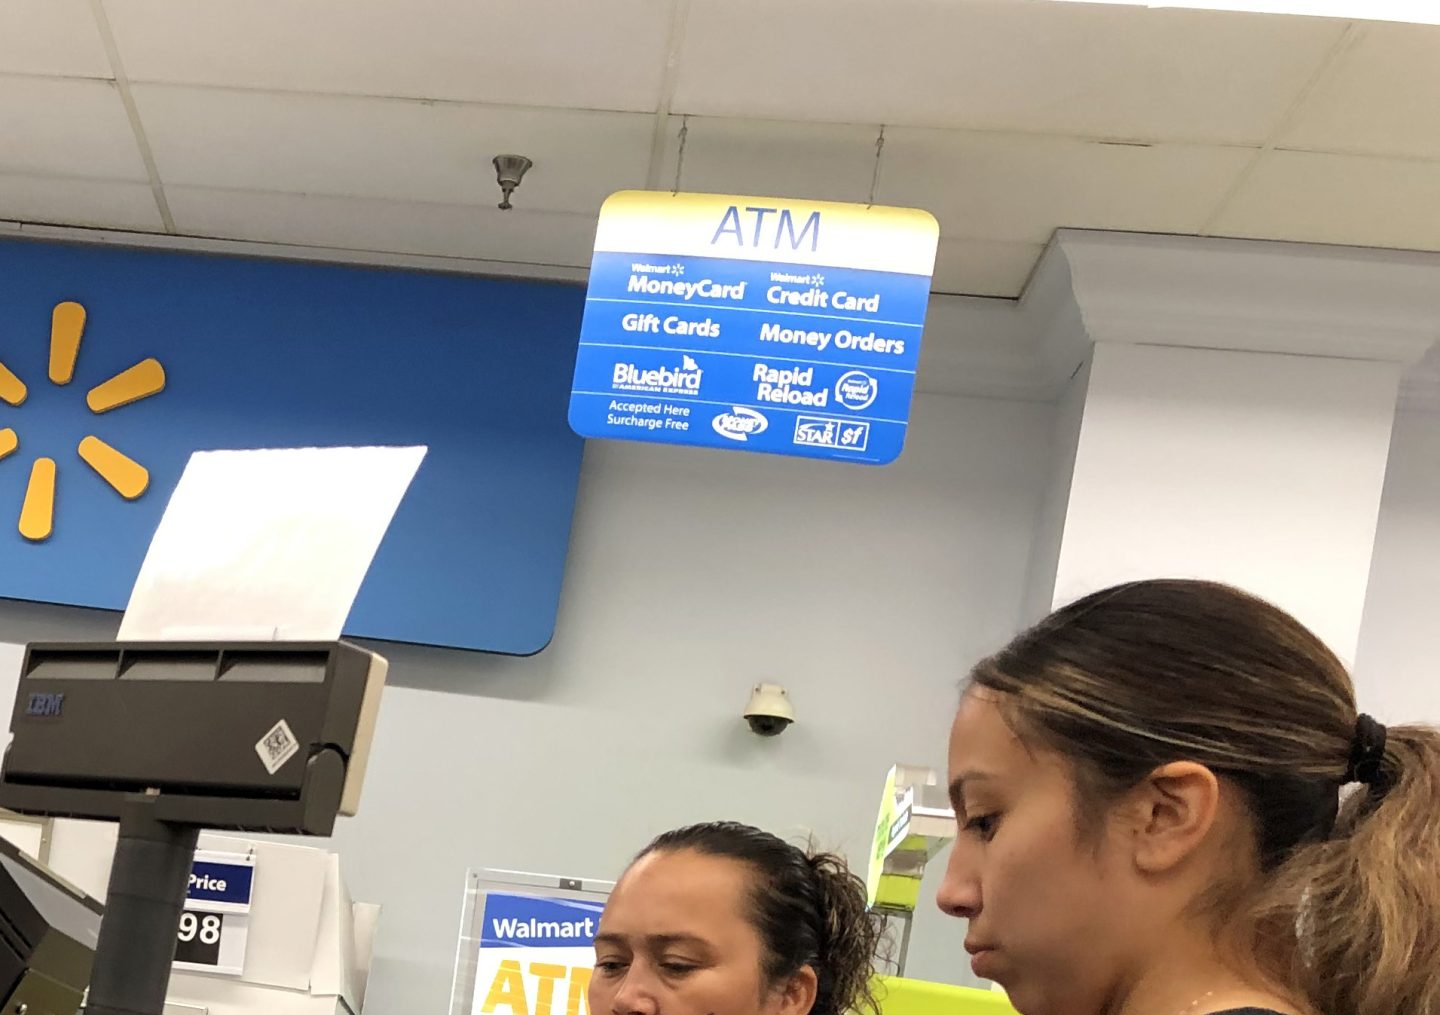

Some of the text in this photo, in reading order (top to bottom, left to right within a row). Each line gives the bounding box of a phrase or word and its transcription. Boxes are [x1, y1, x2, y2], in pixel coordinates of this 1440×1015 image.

[711, 206, 820, 252] ATM
[631, 263, 671, 275] Walmart
[770, 272, 810, 285] Walmart
[627, 275, 746, 300] MoneyCard
[766, 286, 880, 312] Credit Card
[622, 313, 720, 338] Gift Cards
[760, 323, 905, 354] Money Orders
[613, 362, 703, 389] Bluebird
[753, 363, 813, 388] Rapid
[757, 383, 829, 407] Reload
[608, 400, 690, 417] Accepted Here
[607, 414, 689, 430] Surcharge Free
[797, 428, 833, 444] STAR
[177, 912, 221, 945] 98
[492, 917, 594, 939] Walmart
